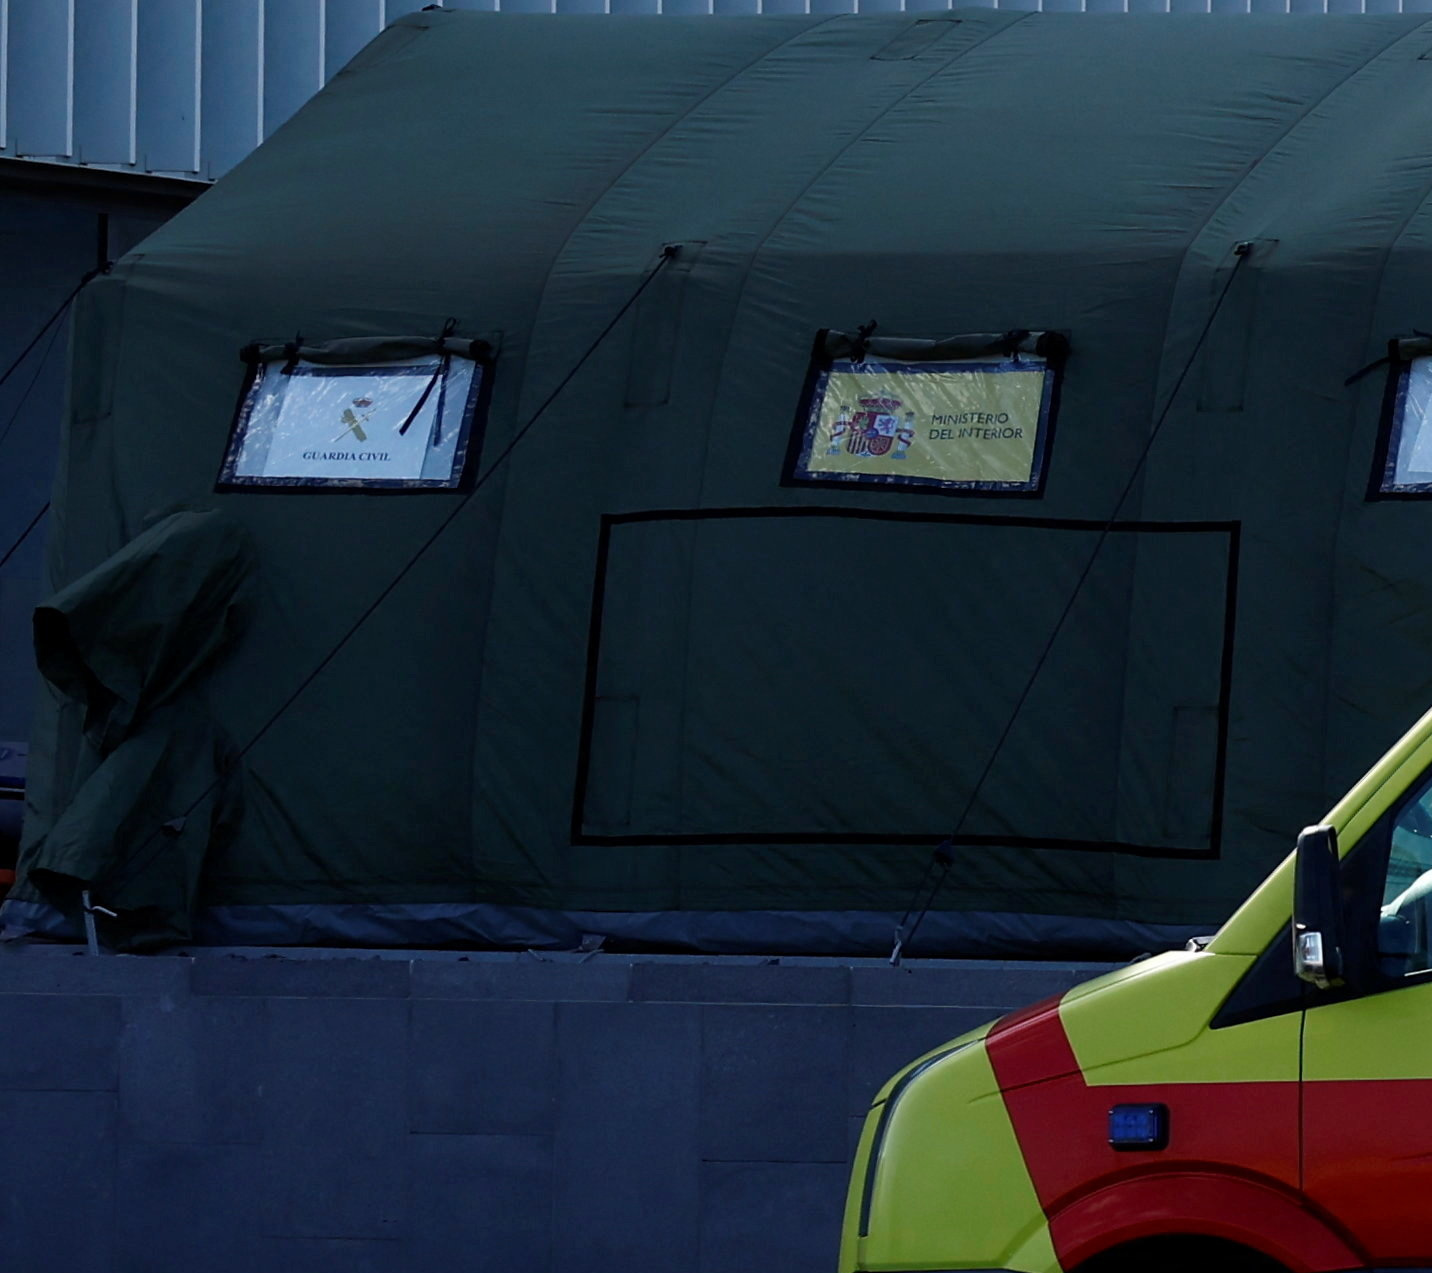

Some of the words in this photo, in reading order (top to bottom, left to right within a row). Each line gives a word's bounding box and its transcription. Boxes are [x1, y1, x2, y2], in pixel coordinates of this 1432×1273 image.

[931, 412, 1009, 425] MINISTERIO
[929, 428, 954, 440] DEL
[958, 427, 1023, 440] INTERIOR
[302, 451, 356, 461] GUARDIA
[358, 451, 391, 462] CIVIL
